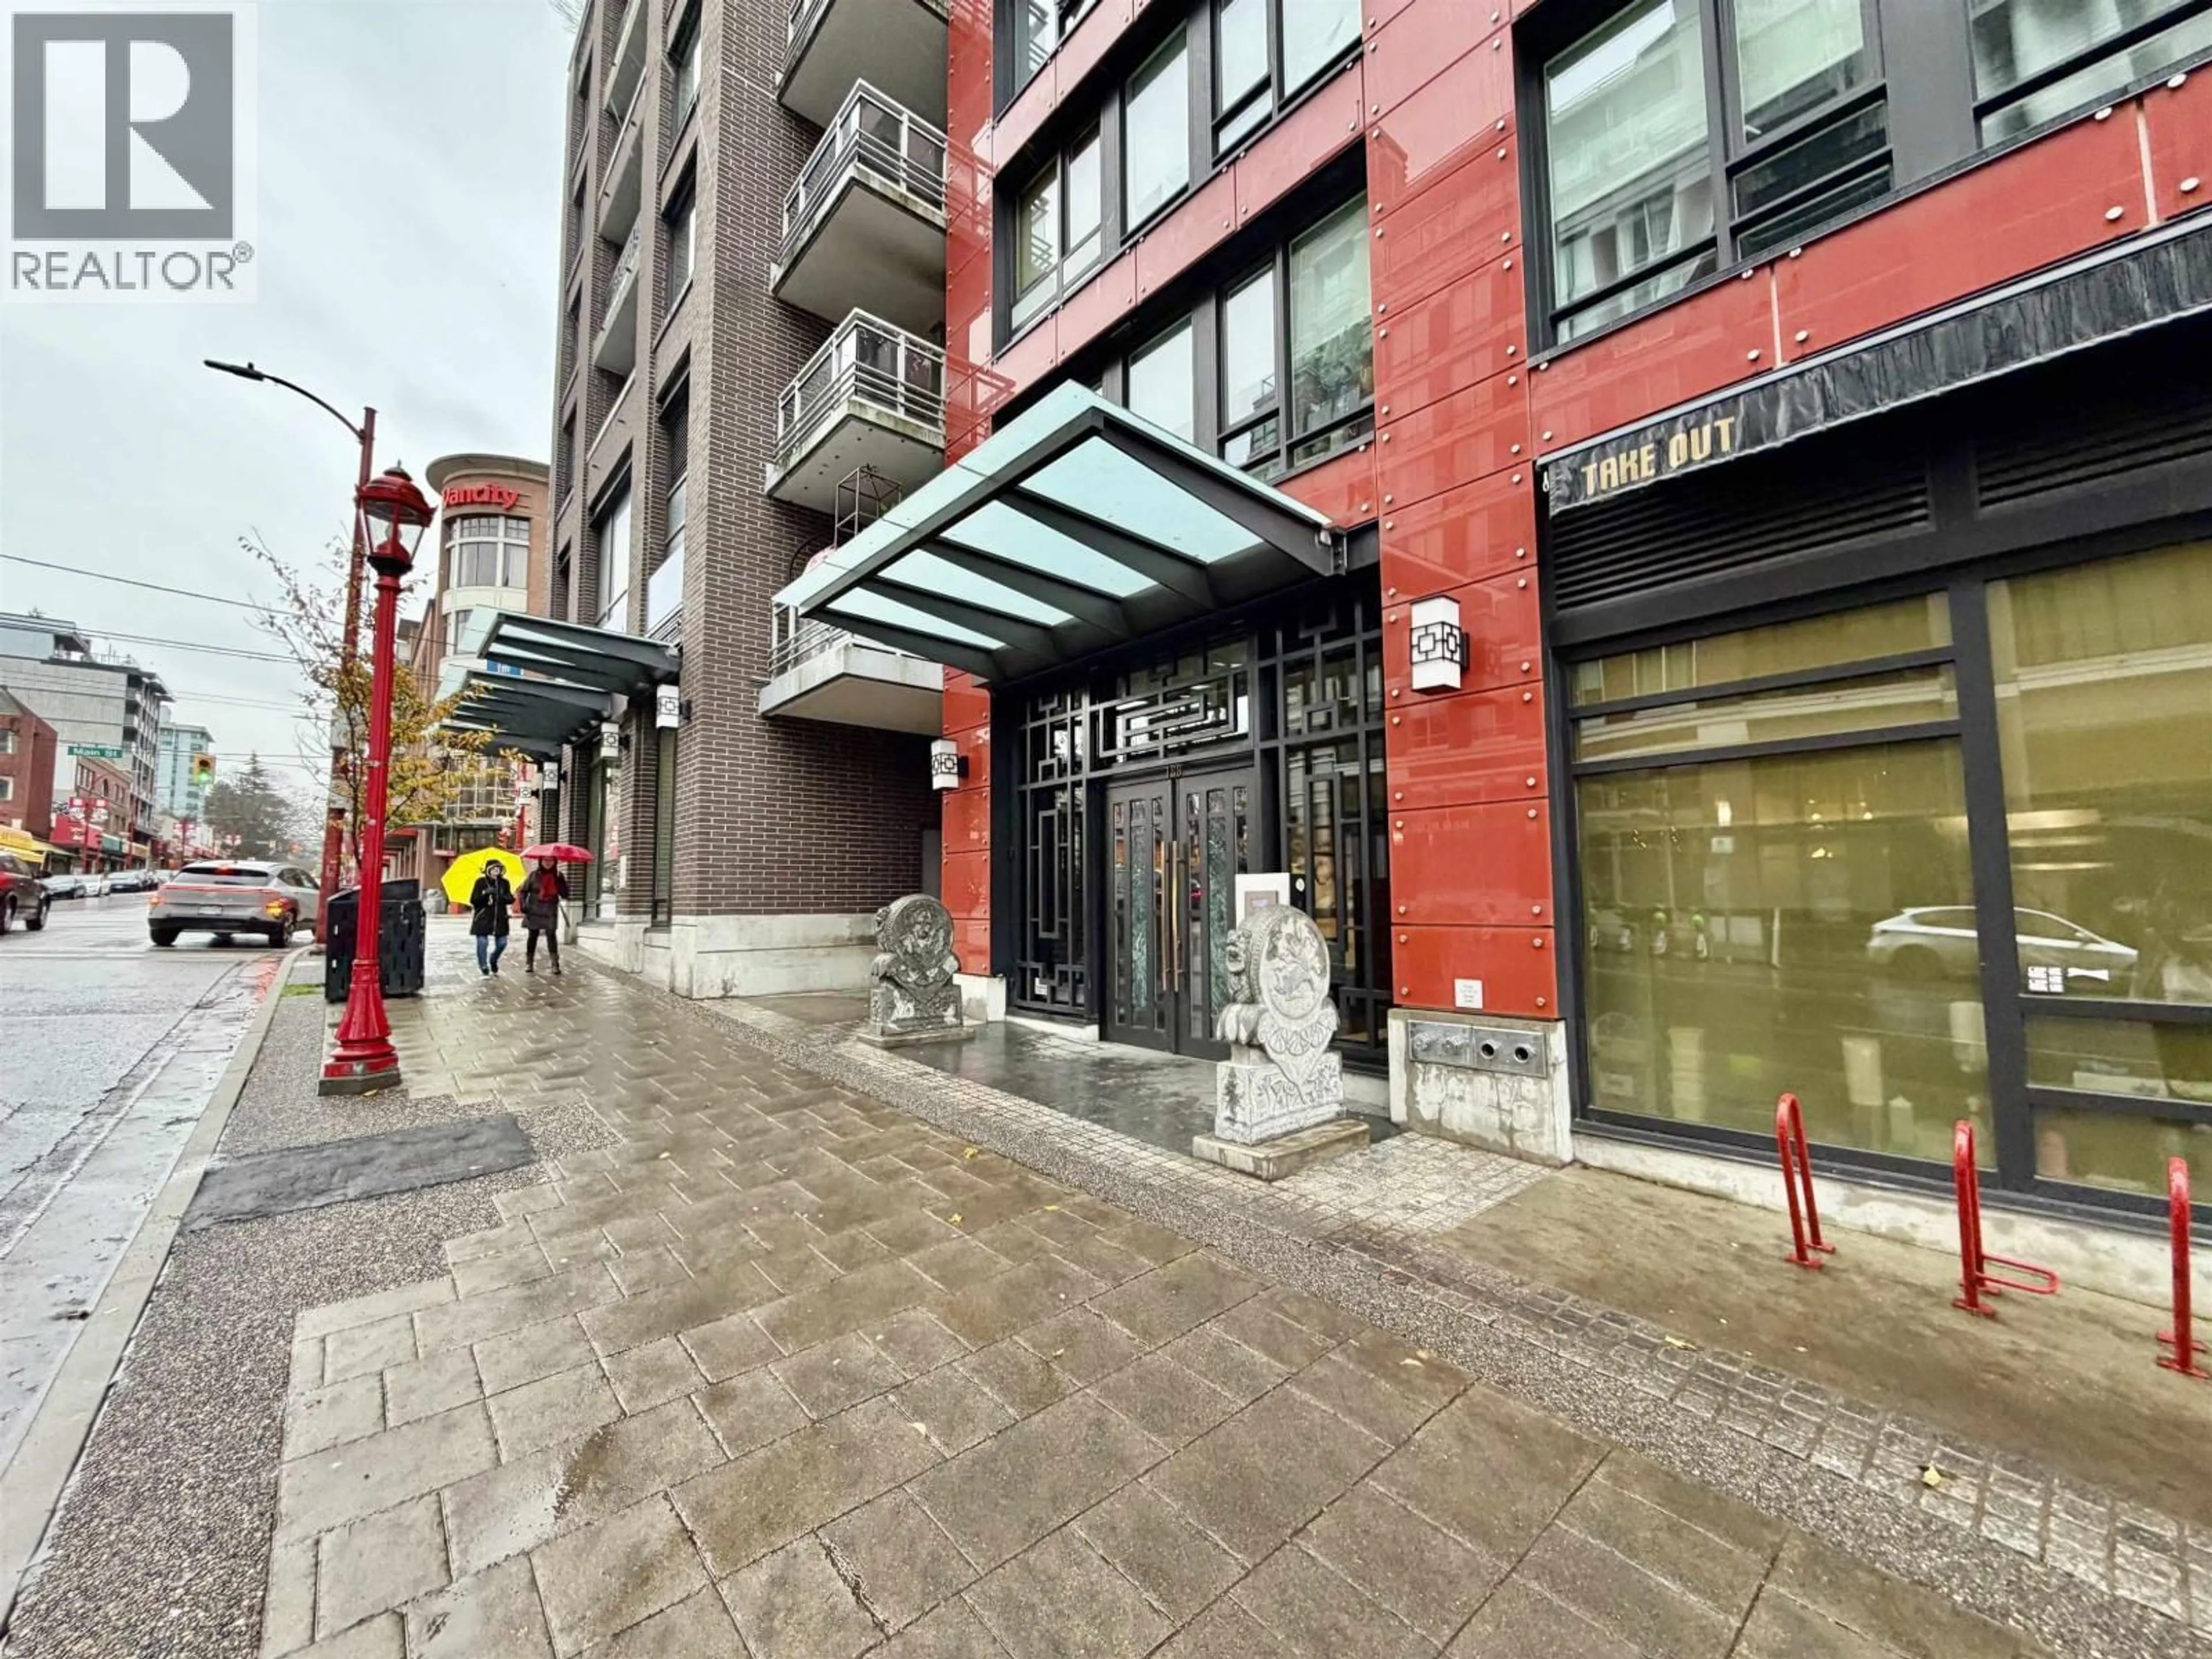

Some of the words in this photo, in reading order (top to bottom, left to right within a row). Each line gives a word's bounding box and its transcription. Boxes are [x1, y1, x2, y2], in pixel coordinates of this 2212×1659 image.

[1582, 443, 1655, 495] TAKE
[1668, 417, 1734, 469] OUT
[73, 748, 101, 756] Main
[105, 749, 118, 757] St
